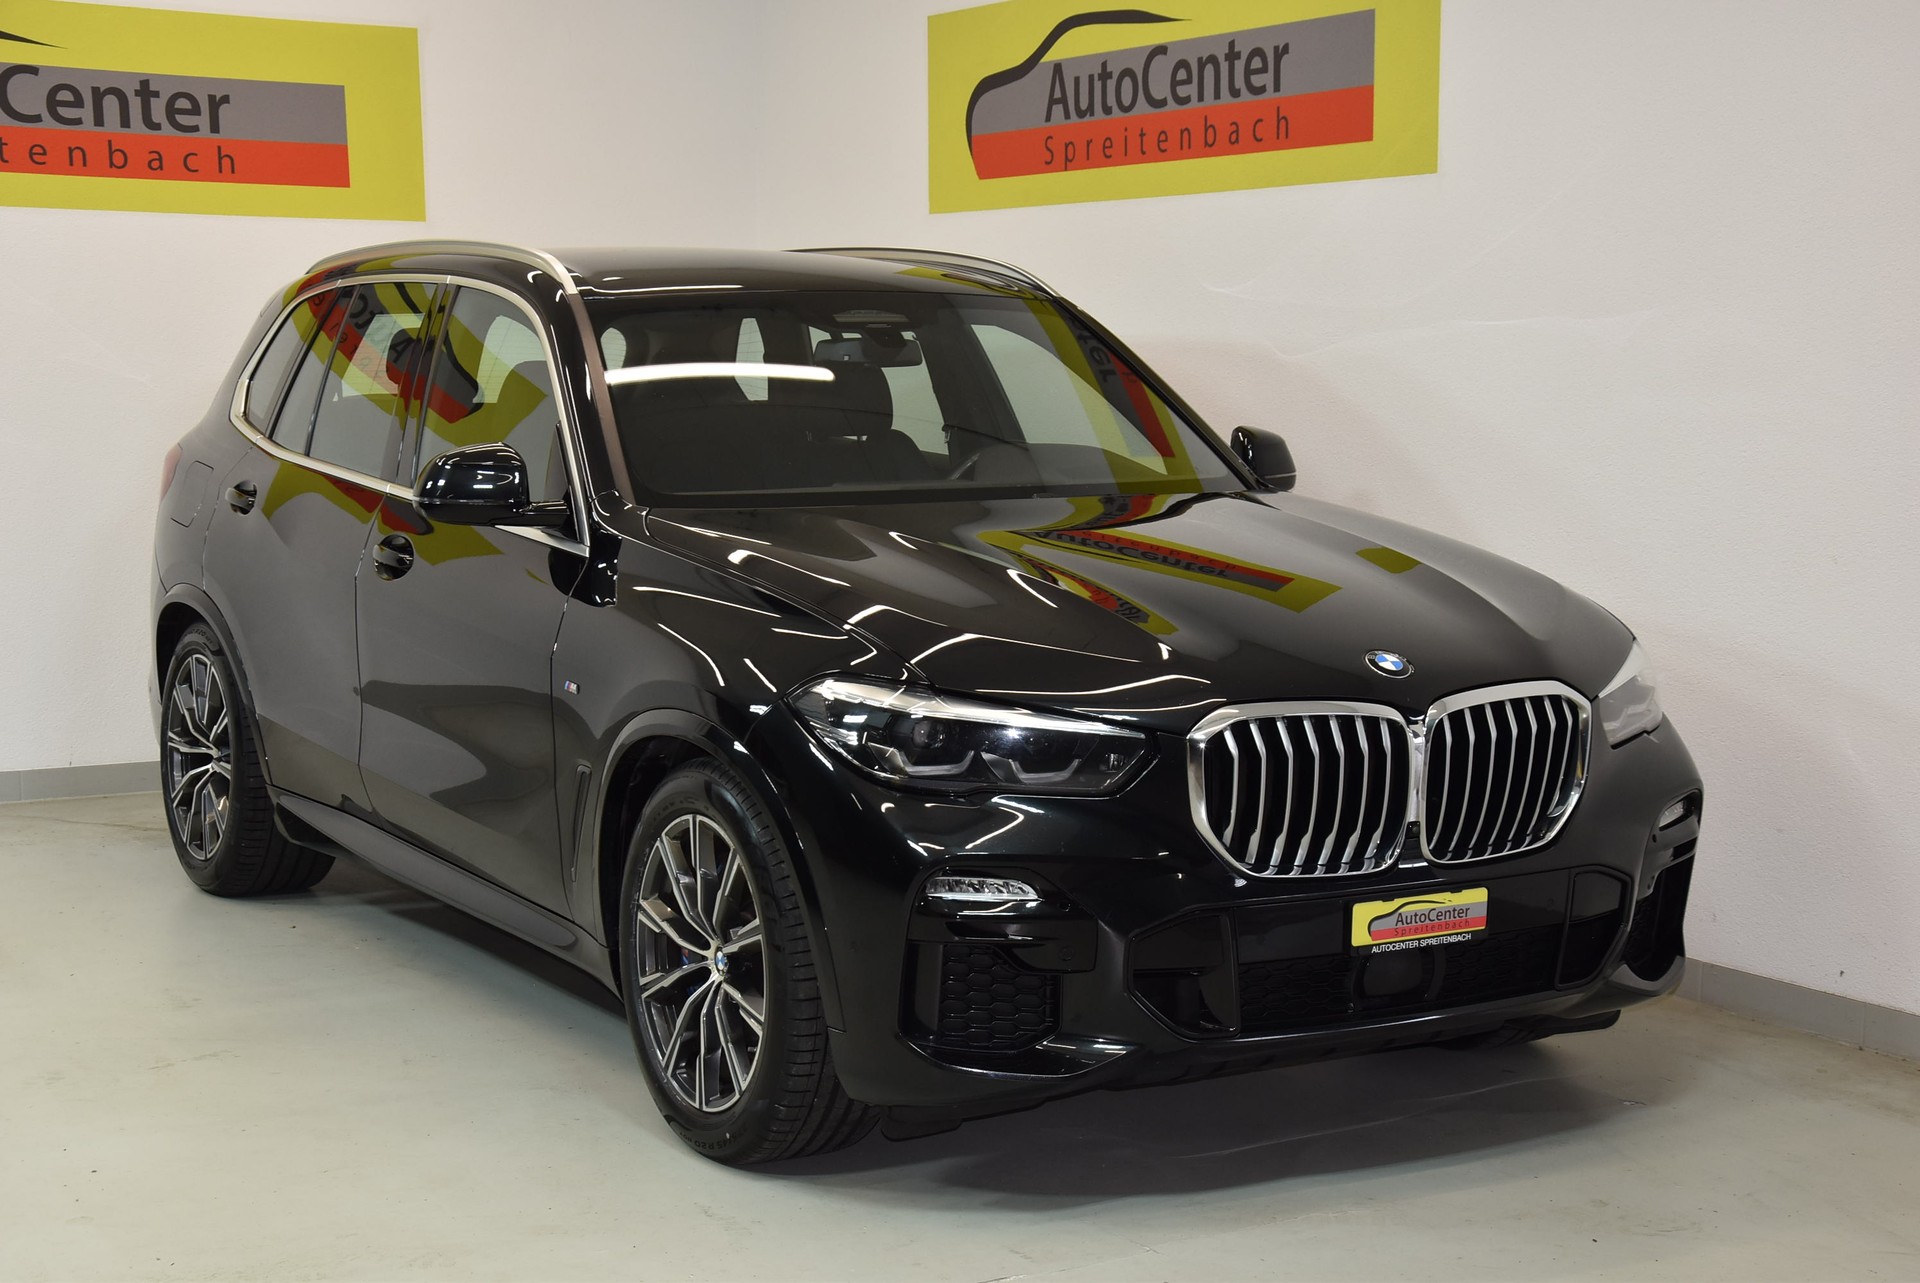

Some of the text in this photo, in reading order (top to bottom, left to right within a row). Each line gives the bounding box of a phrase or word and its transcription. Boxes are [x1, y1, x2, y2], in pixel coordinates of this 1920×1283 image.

[1044, 39, 1290, 123] AutoCenter
[1044, 107, 1290, 171] Spreitenbach
[1395, 907, 1471, 927] AutoCenter
[1394, 920, 1470, 937] Spreitenbach
[1371, 933, 1472, 954] AUTOCENTER SPREITENBACH
